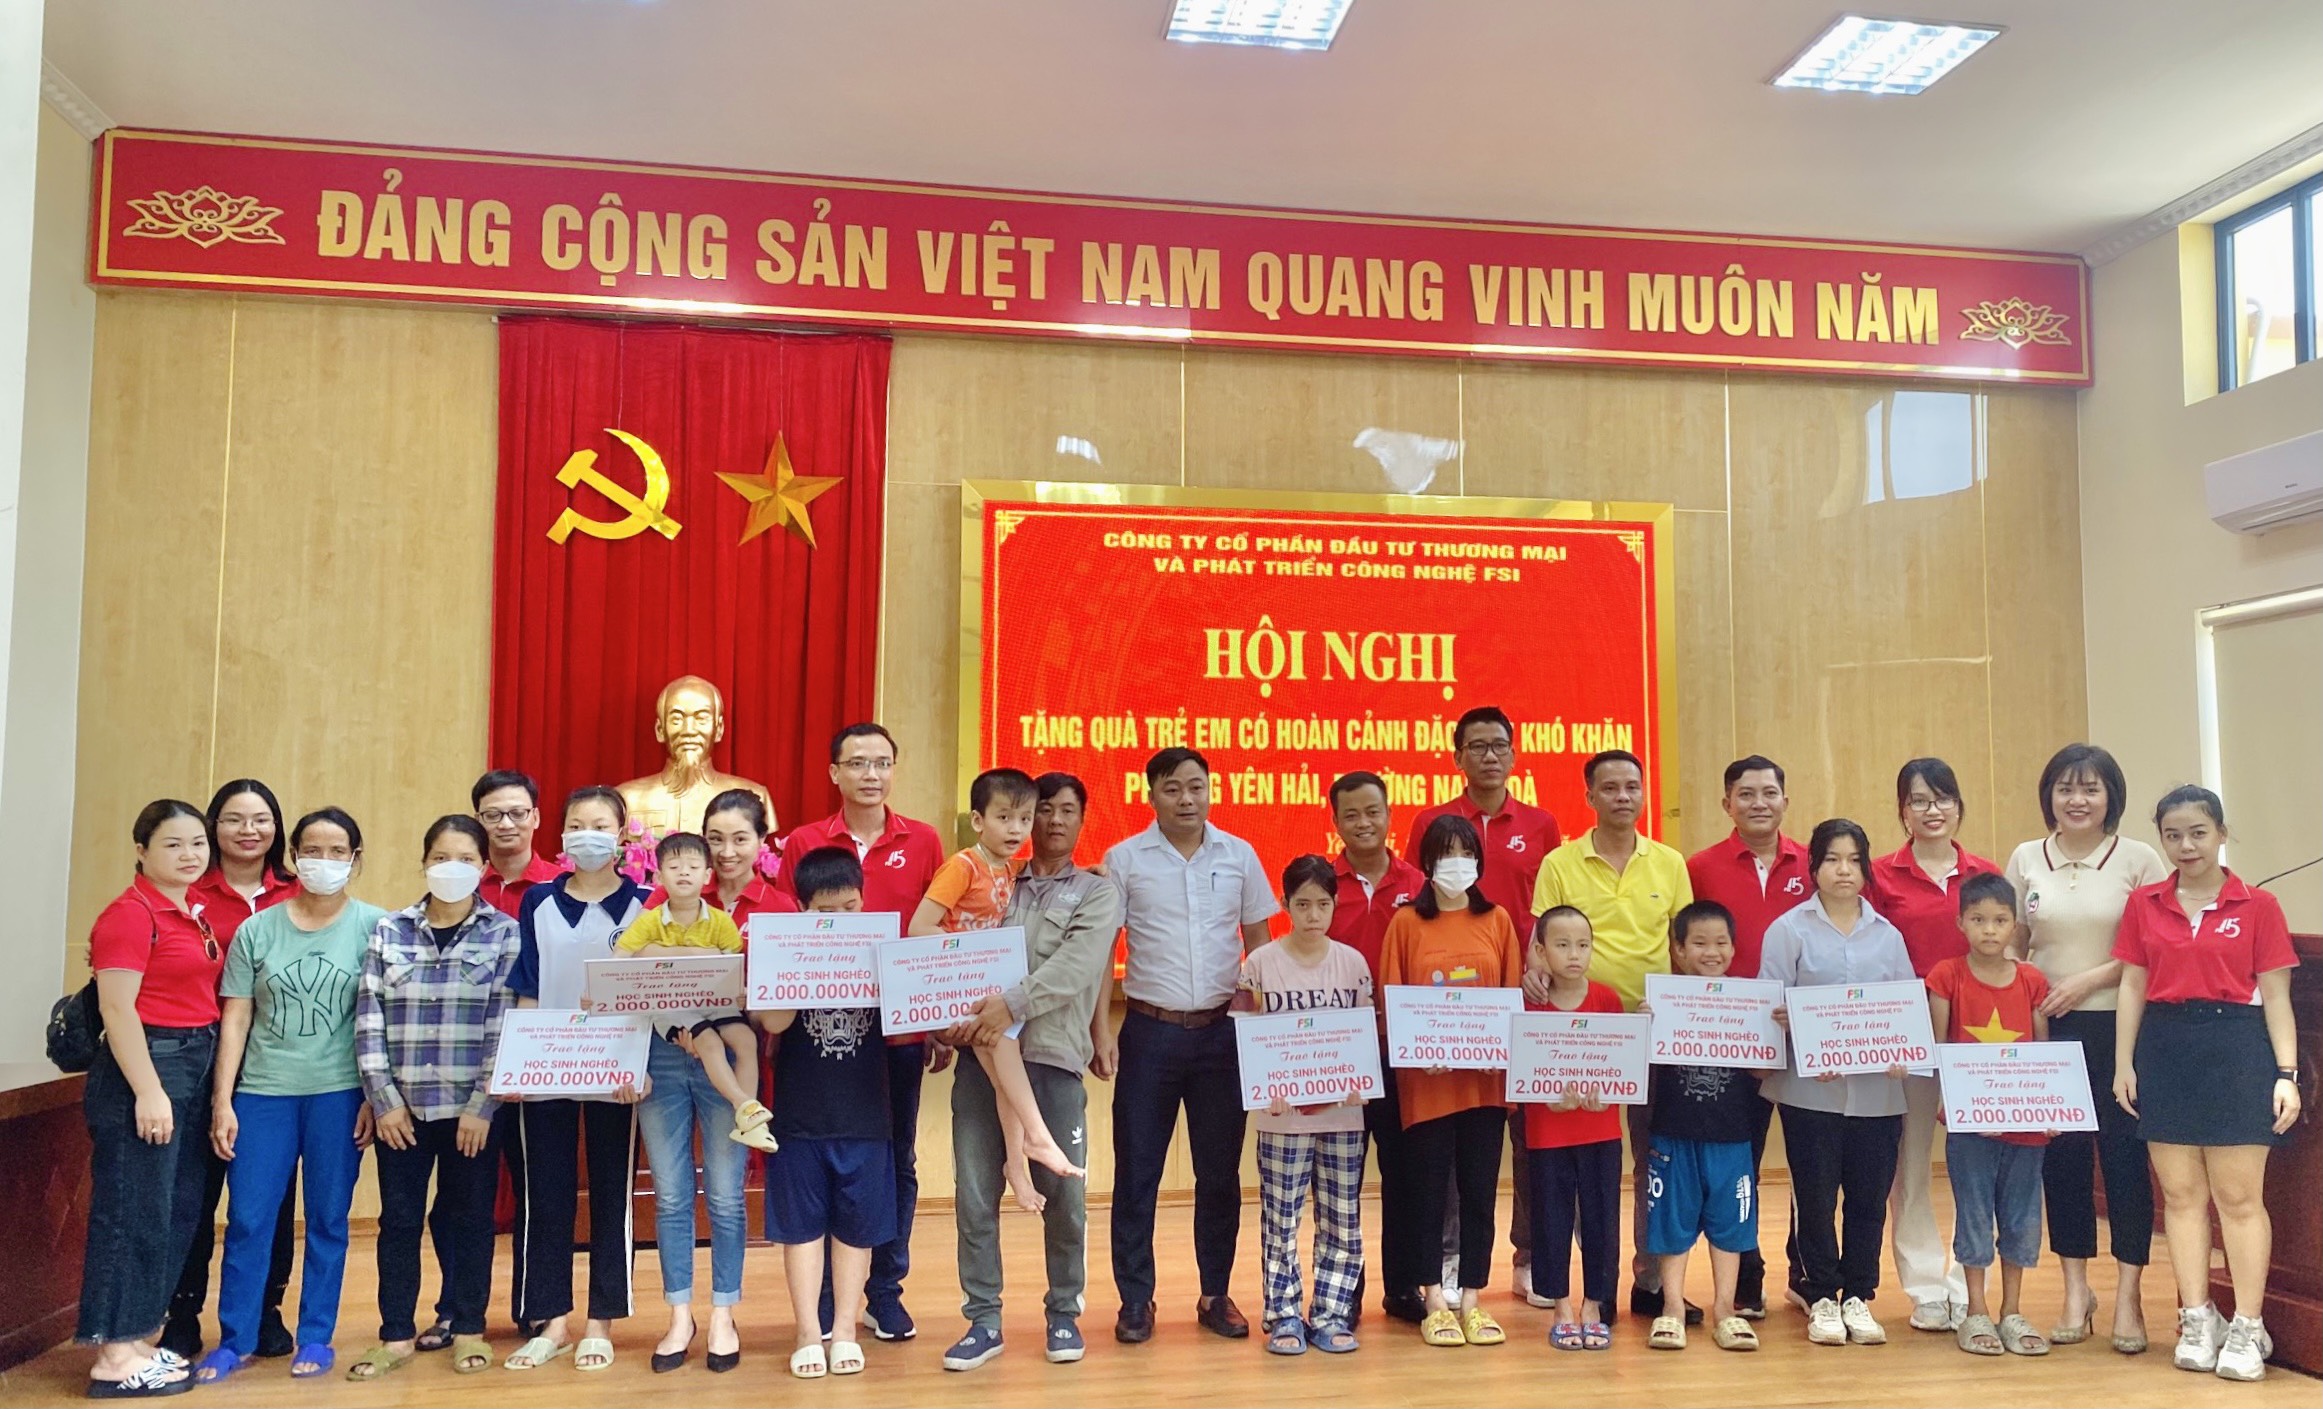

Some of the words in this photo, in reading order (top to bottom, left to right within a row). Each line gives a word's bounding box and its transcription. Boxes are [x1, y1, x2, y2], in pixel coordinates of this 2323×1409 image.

[317, 169, 512, 268] ĐẢNG
[541, 193, 728, 286] CỘNG
[755, 198, 888, 291] SẢN
[917, 221, 1055, 310] VIỆT
[1082, 241, 1220, 311] NAM
[1248, 251, 1443, 324] QUANG
[1471, 266, 1604, 330] VINH
[1628, 264, 1794, 339] MUÔN
[1816, 270, 1939, 346] NĂM
[1104, 531, 1171, 549] CÔNG
[1179, 535, 1208, 550] TY
[1385, 541, 1416, 556] TƯ
[1421, 542, 1515, 559] THƯƠNG
[1522, 546, 1567, 563] MẠI
[1154, 556, 1185, 573] VÀ
[1193, 558, 1256, 574] PHÁT
[1341, 561, 1406, 579] CÔNG
[1414, 563, 1476, 583] NGHỆ
[1484, 567, 1520, 582] FSI
[1203, 614, 1307, 698] HỘI
[1322, 631, 1457, 701] NGHỊ
[1020, 710, 1083, 754] TẶNG
[1090, 710, 1138, 752] QUÀ
[1145, 707, 1187, 749] TRẺ
[1195, 717, 1231, 748] EM
[1239, 712, 1269, 750] CÓ
[1276, 711, 1338, 750] HOÀN
[1346, 710, 1408, 750] CẢNH
[1521, 716, 1565, 753] KHÓ
[1572, 717, 1633, 753] KHĂN
[1229, 766, 1273, 804] YÊN
[816, 918, 834, 928] FSI
[942, 938, 960, 949] FSI
[793, 951, 823, 962] Trao
[777, 971, 800, 982] HỌC
[805, 970, 830, 980] SINH
[834, 968, 870, 979] NGHÈO
[923, 971, 953, 985] Trao
[632, 981, 664, 989] Trao
[1706, 982, 1722, 992] FSI
[616, 993, 640, 1001] HỌC
[675, 989, 713, 997] NGHÈO
[909, 992, 932, 1005] HỌC
[936, 989, 961, 1001] SINH
[965, 982, 1001, 997] NGHÈO
[1445, 991, 1462, 1000] FSI
[1846, 988, 1864, 998] FSI
[597, 997, 732, 1011] 2.000.000VNĐ
[1264, 988, 1358, 1013] DREAM
[1297, 1017, 1314, 1027] FSI
[1571, 1018, 1588, 1028] FSI
[1687, 1011, 1714, 1023] Trao
[1427, 1019, 1455, 1028] Trao
[1831, 1019, 1860, 1031] Trao
[1415, 1035, 1436, 1044] HỌC
[1440, 1035, 1463, 1043] SINH
[1466, 1034, 1501, 1044] NGHÈO
[1673, 1029, 1694, 1040] HỌC
[1698, 1030, 1721, 1040] SINH
[1725, 1030, 1758, 1041] NGHÈO
[542, 1042, 573, 1052] Trao
[1820, 1039, 1842, 1050] HỌC
[1845, 1037, 1869, 1047] SINH
[1872, 1033, 1907, 1045] NGHÈO
[1280, 1049, 1308, 1062] Trao
[1399, 1046, 1508, 1061] 2.000.000VN
[1549, 1049, 1577, 1060] Trao
[1657, 1040, 1776, 1060] 2.000.000VNĐ
[2000, 1048, 2018, 1057] FSI
[1805, 1045, 1928, 1068] 2.000.000VNĐ
[523, 1060, 548, 1069] HỌC
[551, 1059, 578, 1068] SINH
[580, 1058, 618, 1068] NGHÈO
[1268, 1069, 1289, 1082] HỌC
[1293, 1067, 1317, 1078] SINH
[1320, 1061, 1354, 1075] NGHÈO
[1534, 1067, 1555, 1077] HỌC
[1559, 1067, 1583, 1076] SINH
[1586, 1066, 1621, 1077] NGHÈO
[501, 1071, 635, 1085] 2.000.000VNĐ
[1983, 1078, 2014, 1088] Trao
[1251, 1074, 1374, 1100] 2.000.000VNĐ
[1515, 1079, 1637, 1095] 2.000000VNĐ
[1971, 1096, 1995, 1106] HỌC
[1998, 1096, 2024, 1105] SINH
[2026, 1094, 2064, 1104] NGHÈO
[1955, 1107, 2086, 1123] 2.000.000VNĐ
